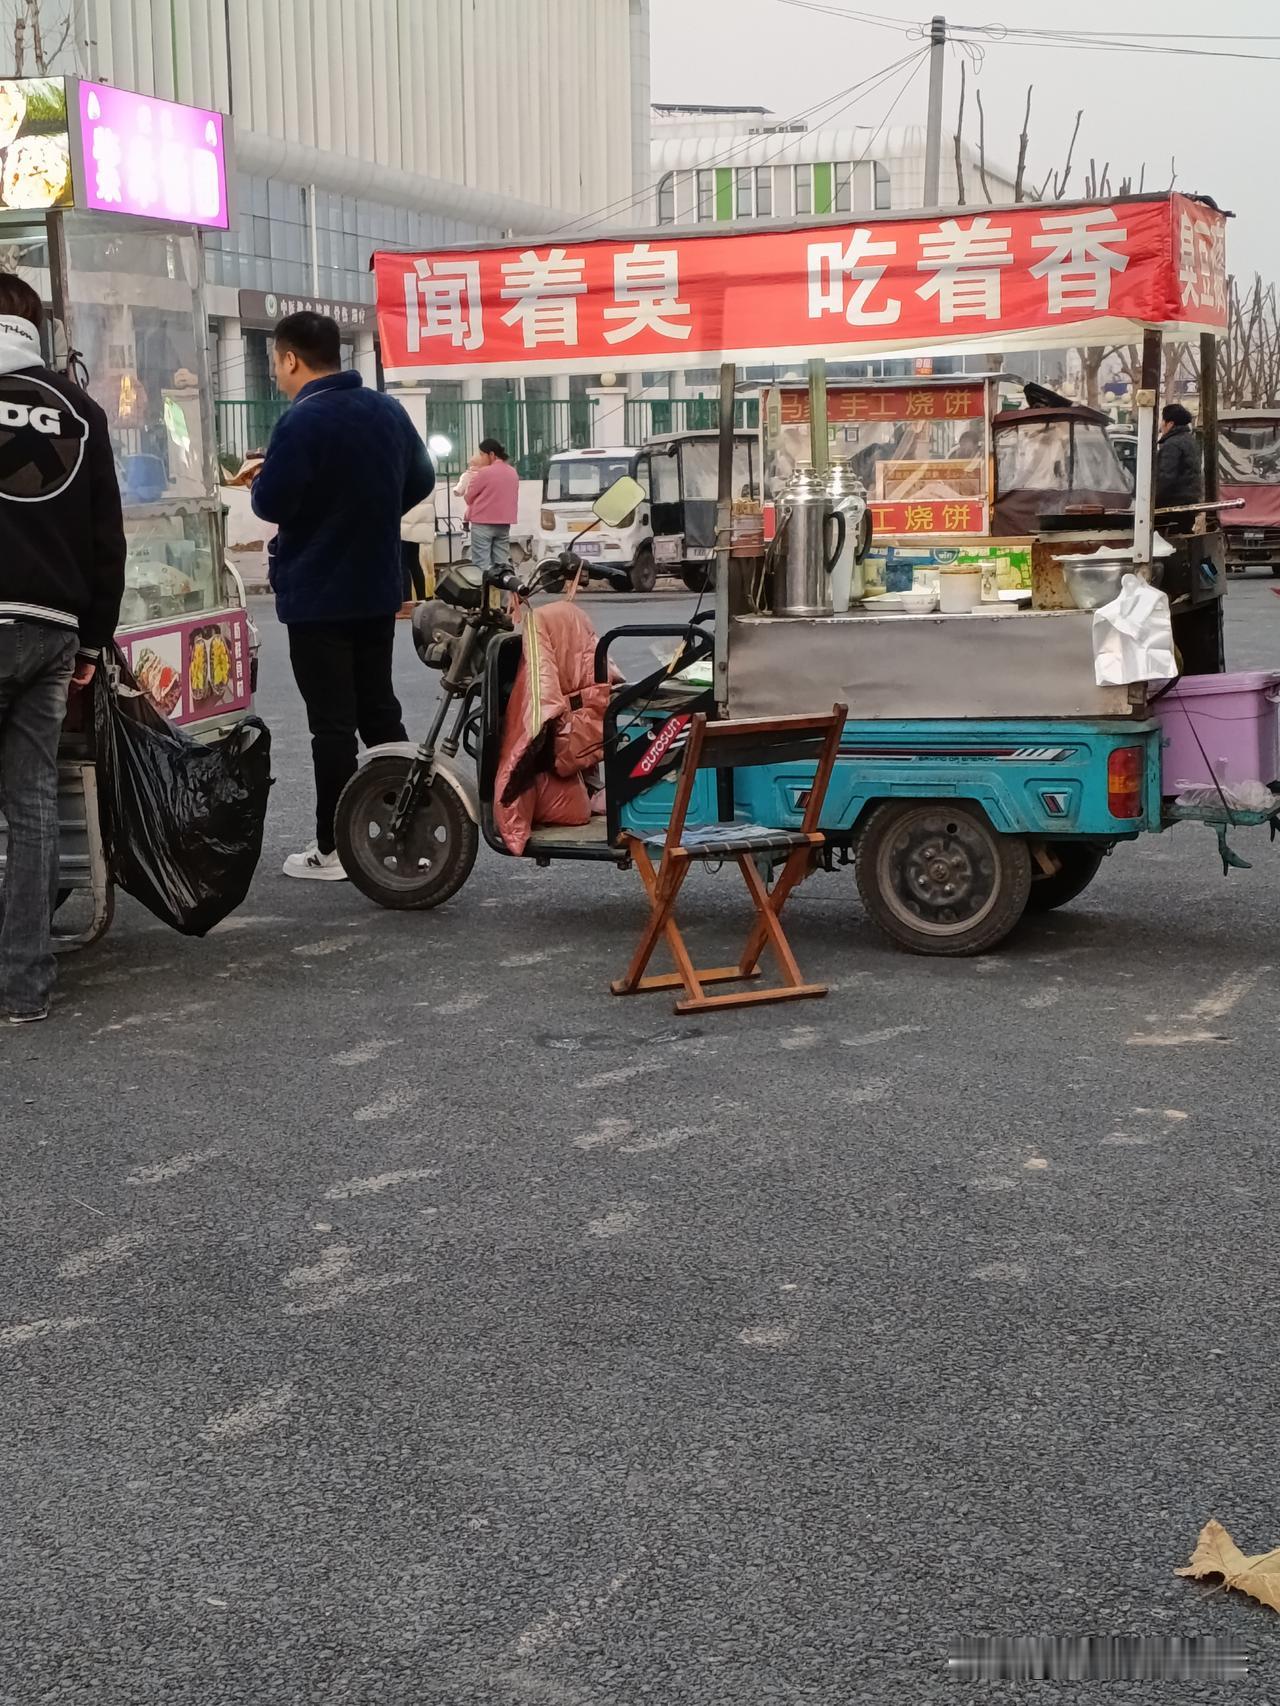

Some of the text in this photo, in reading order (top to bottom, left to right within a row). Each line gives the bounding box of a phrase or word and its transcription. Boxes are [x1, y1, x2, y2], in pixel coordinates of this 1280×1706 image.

[404, 208, 1130, 352] 闻着臭 吃着香
[641, 718, 681, 772] autosun
